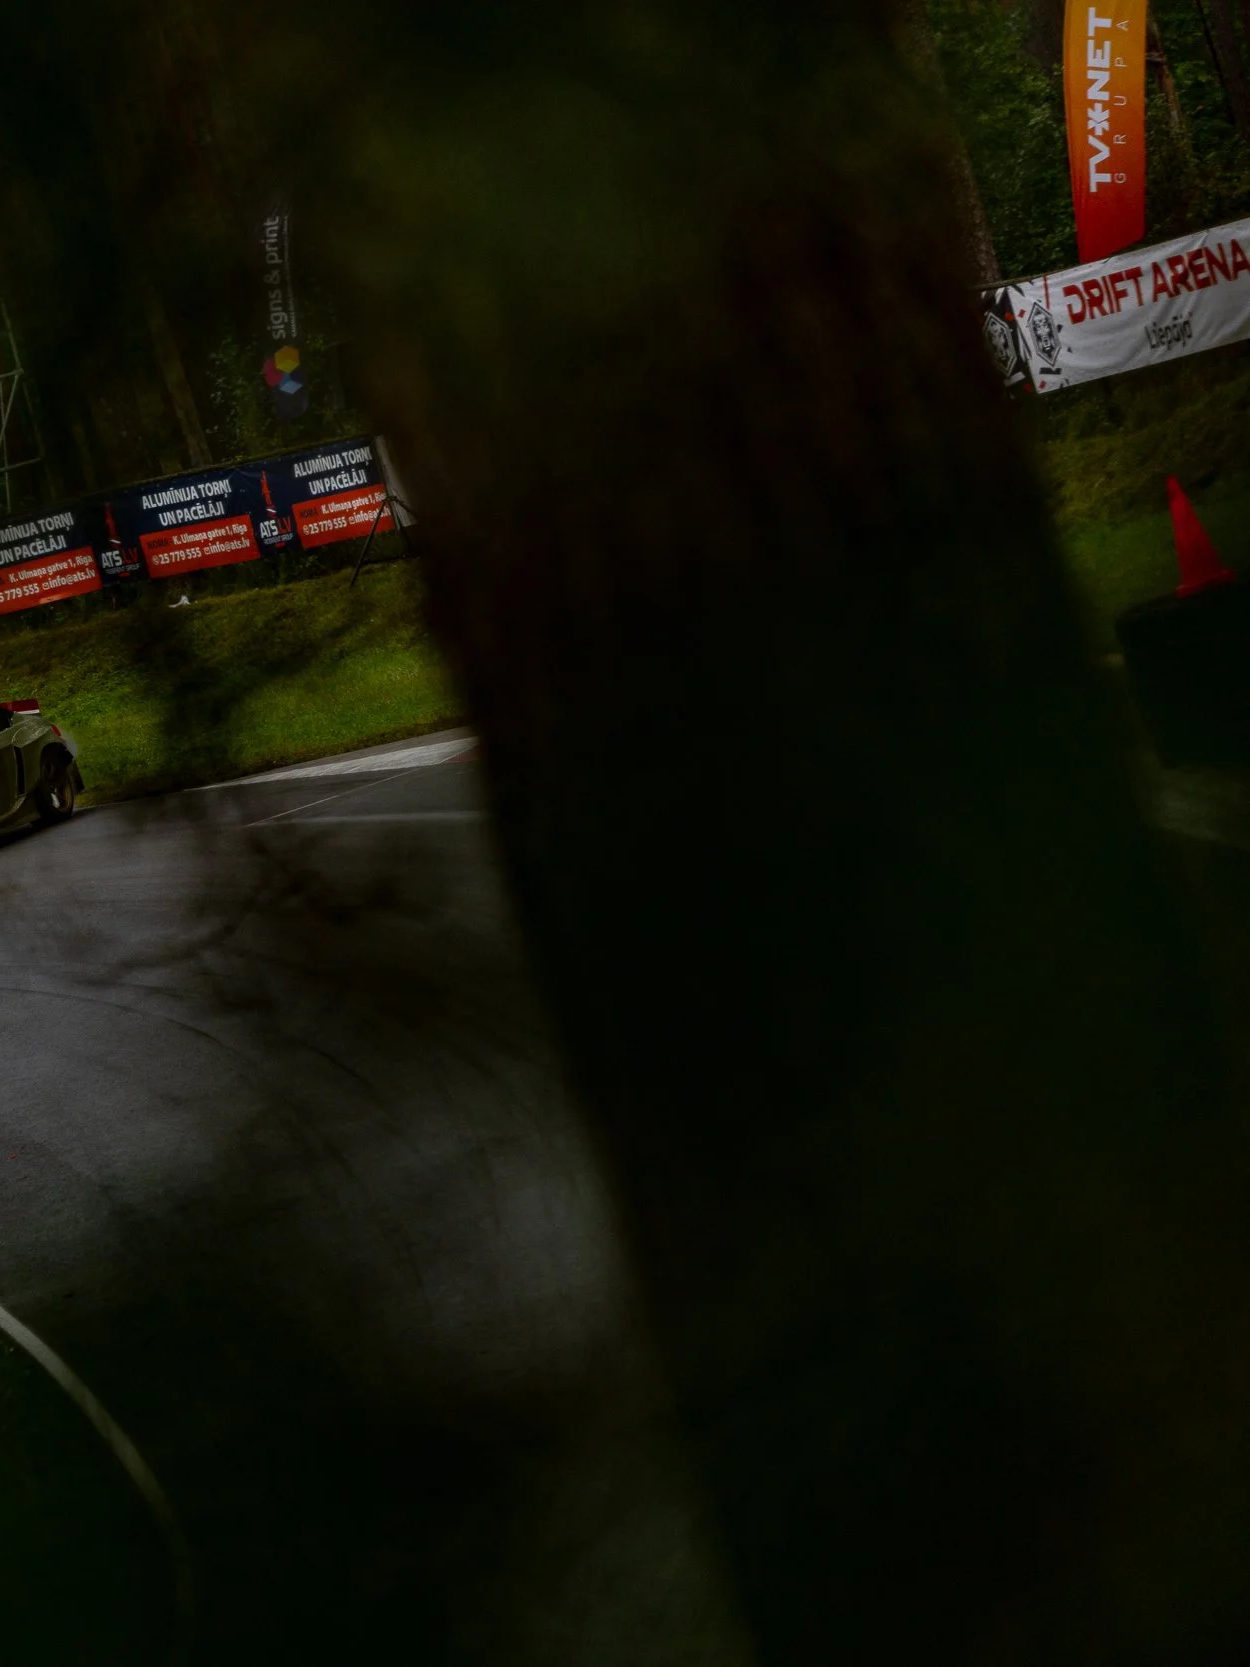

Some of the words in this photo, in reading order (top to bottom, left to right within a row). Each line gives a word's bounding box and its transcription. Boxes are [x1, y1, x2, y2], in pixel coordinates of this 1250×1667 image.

[260, 215, 283, 264] print
[263, 270, 280, 284] &
[1063, 267, 1143, 324] DRIFT
[1152, 239, 1250, 302] ARENA
[267, 289, 288, 340] signs
[293, 454, 343, 478] ALUMĪNIJA
[308, 480, 326, 495] UN
[326, 469, 367, 492] PACĒLĀJI
[142, 487, 199, 510] ALUMĪNIJA
[159, 512, 177, 526] UN
[177, 501, 225, 524] PACĒLĀJI
[310, 523, 319, 534] 25
[319, 520, 333, 531] 779
[333, 516, 347, 528] 555
[15, 534, 67, 561] PACĒLĀJI
[159, 553, 170, 564] 25
[170, 550, 186, 562] 779
[186, 547, 201, 559] 555
[9, 573, 18, 583] K.
[68, 559, 76, 568] 1,
[5, 588, 22, 600] 779
[22, 583, 39, 595] 555
[49, 569, 95, 588] info@ats.lv
